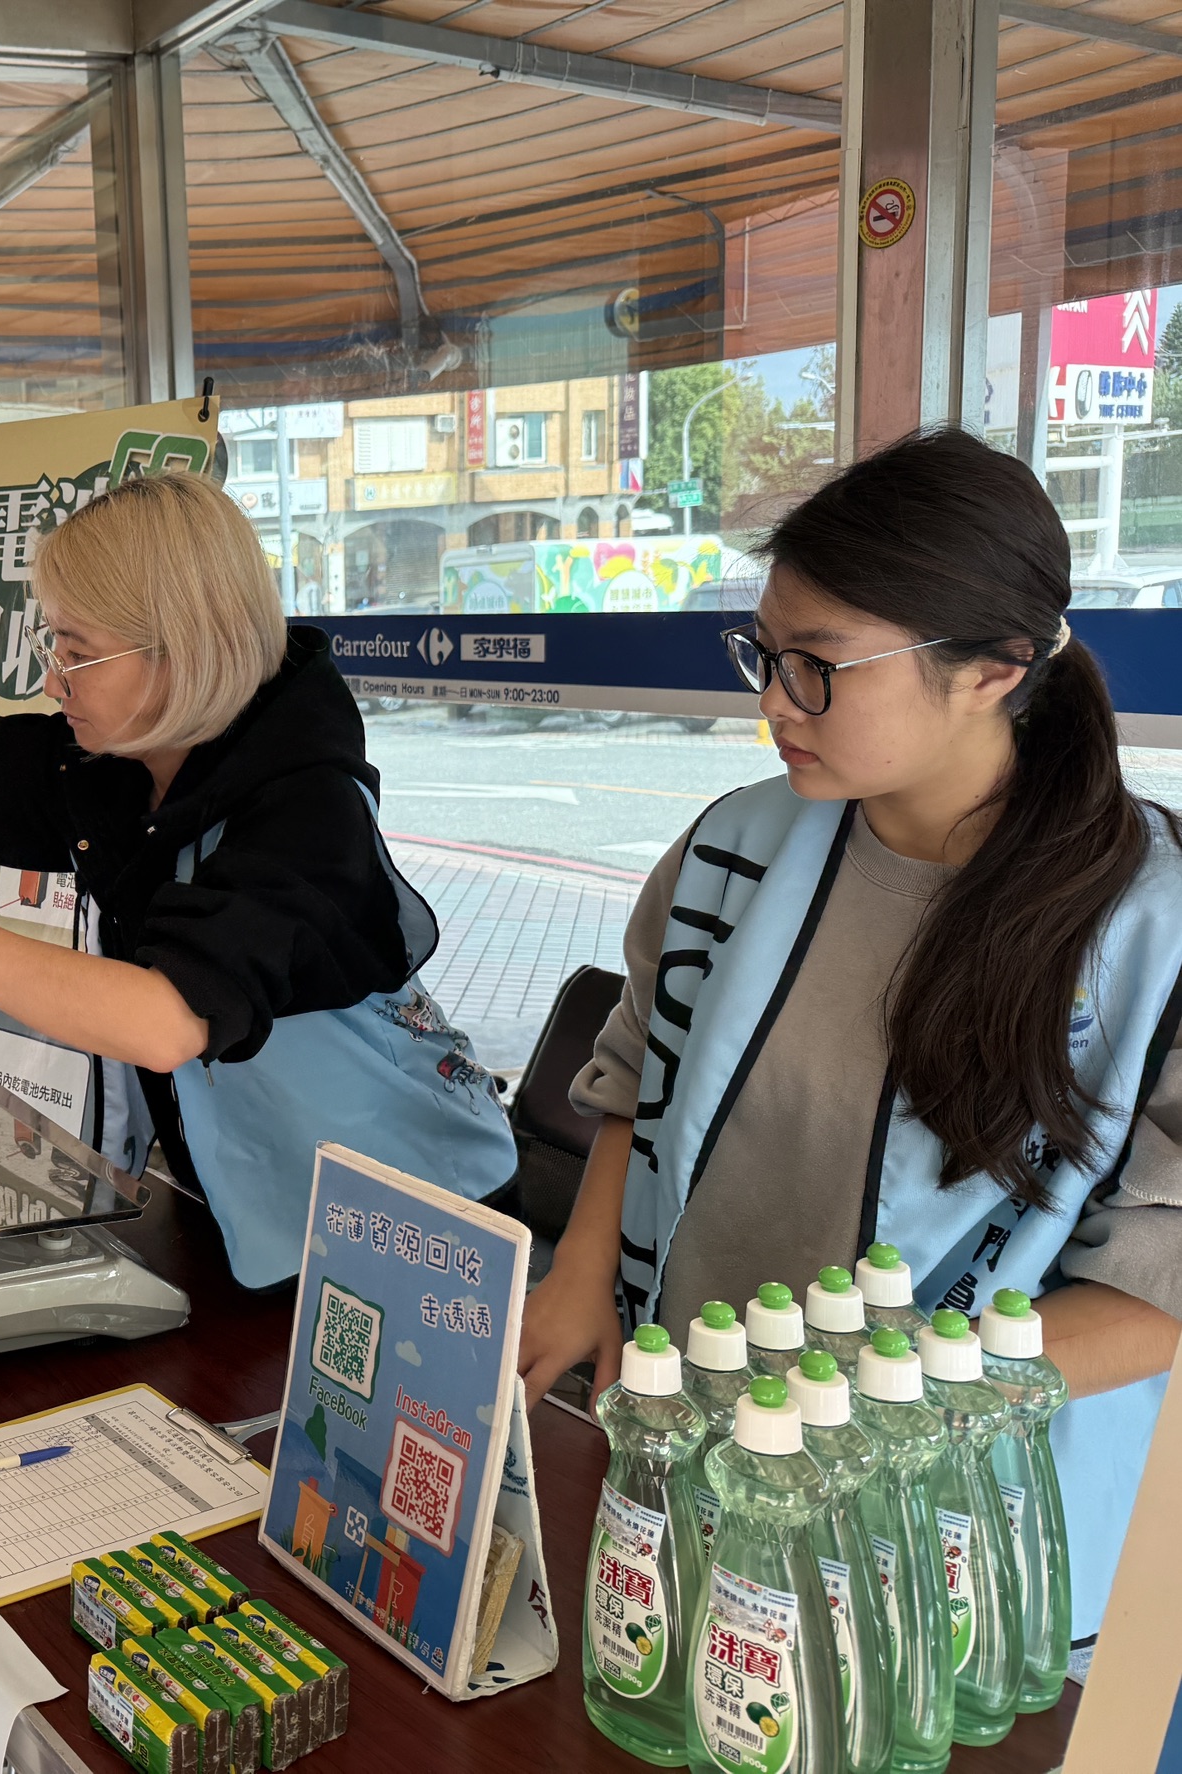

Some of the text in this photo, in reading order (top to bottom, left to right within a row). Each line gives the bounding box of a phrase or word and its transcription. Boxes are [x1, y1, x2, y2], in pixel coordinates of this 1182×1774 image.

[332, 633, 410, 658] Carrefour
[473, 636, 532, 659] 家樂福
[363, 681, 398, 696] Opening
[401, 682, 425, 696] Hours
[503, 687, 560, 704] 9:00~23:00
[326, 1202, 483, 1286] 花蓮資源回收
[420, 1293, 492, 1338] 走透透
[309, 1374, 368, 1431] FaceBook
[395, 1384, 473, 1451] InstaGram
[598, 1550, 655, 1610] 洗寶
[594, 1606, 622, 1639] 洗潔精
[707, 1623, 781, 1688] 洗寶
[704, 1687, 742, 1720] 洗潔精
